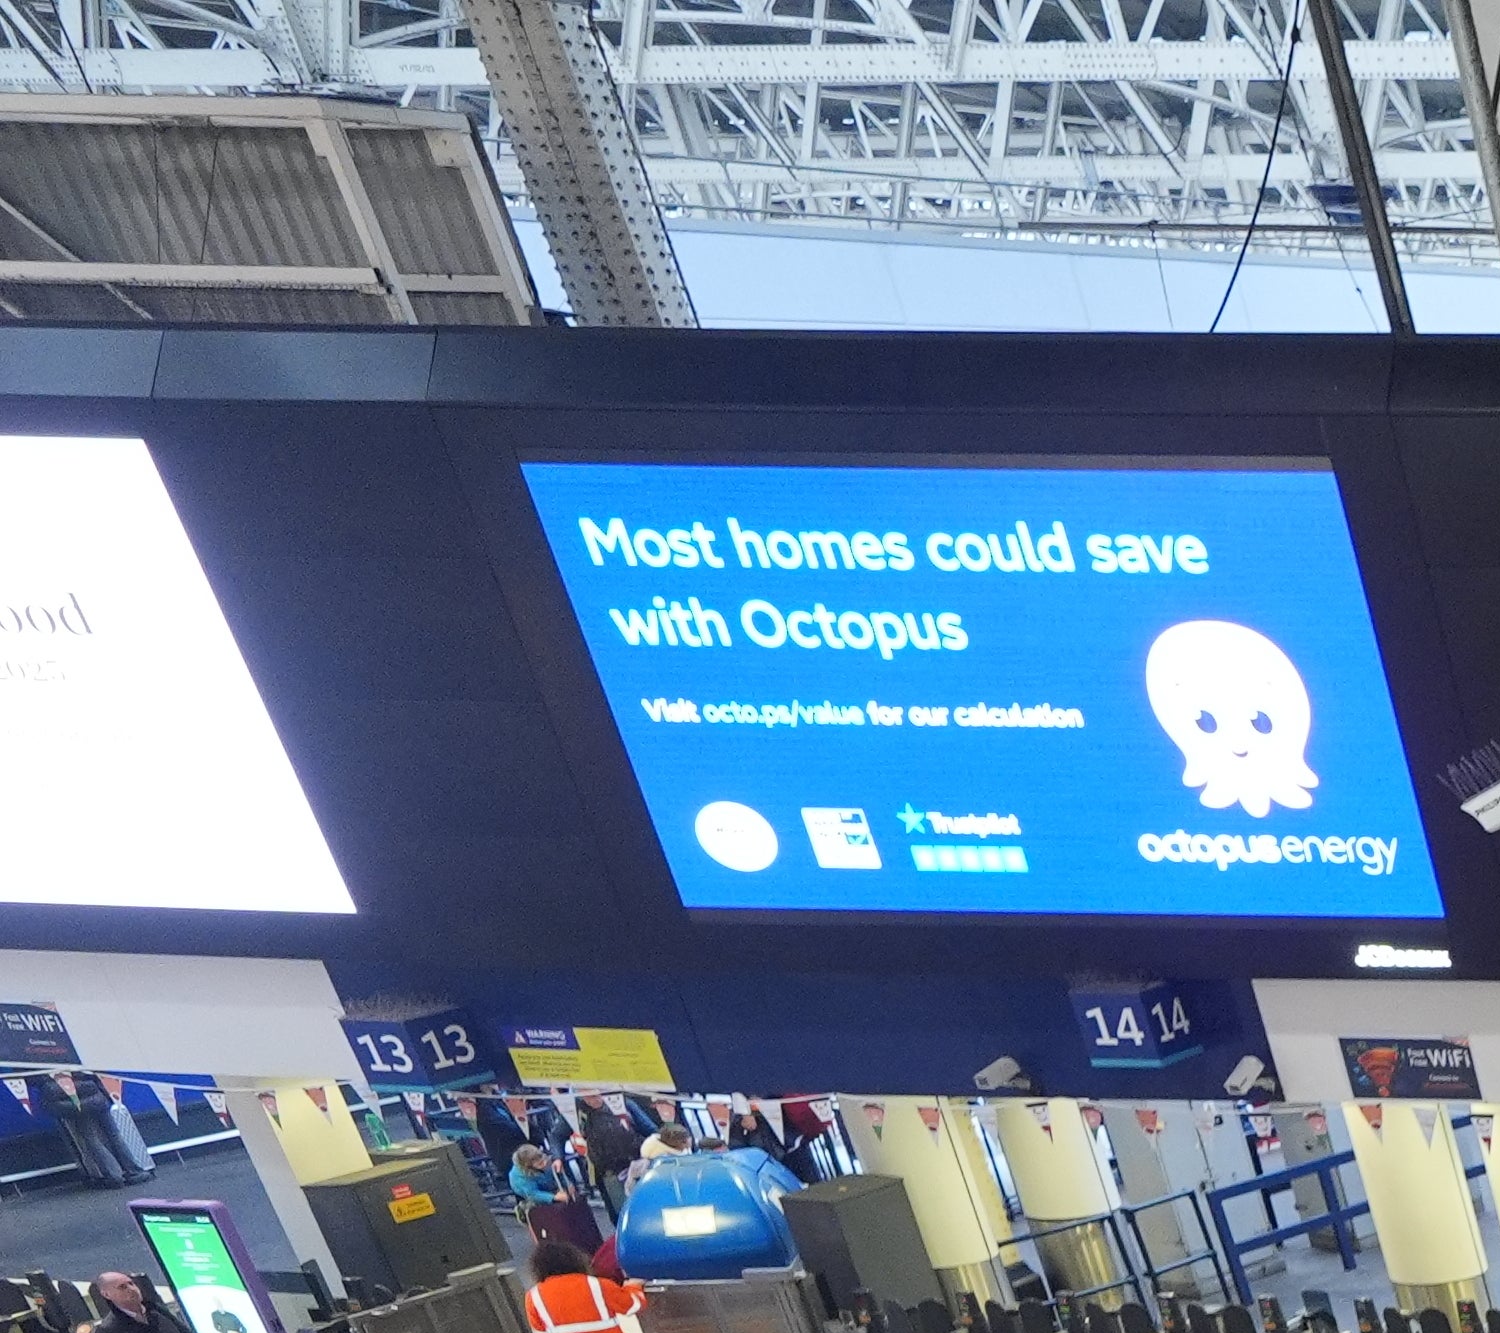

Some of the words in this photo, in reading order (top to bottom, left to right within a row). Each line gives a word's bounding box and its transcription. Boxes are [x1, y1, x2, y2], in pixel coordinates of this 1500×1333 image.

[578, 517, 724, 569] Most
[726, 517, 915, 571] homes
[926, 520, 1076, 573] could
[1086, 532, 1210, 574] save
[608, 596, 732, 648] with
[740, 599, 969, 661] Octopus
[640, 698, 702, 723] Visit
[703, 700, 865, 728] octo.ps/value
[866, 701, 903, 726] for
[908, 706, 948, 726] our
[954, 703, 1085, 728] calculation
[926, 811, 1022, 838] Trustpilot
[20, 1013, 65, 1033] WiFi
[1086, 1007, 1145, 1047] 14
[1151, 997, 1190, 1043] 14
[355, 1034, 413, 1074] 13
[421, 1024, 475, 1070] 13
[1426, 1048, 1472, 1068] WiFi
